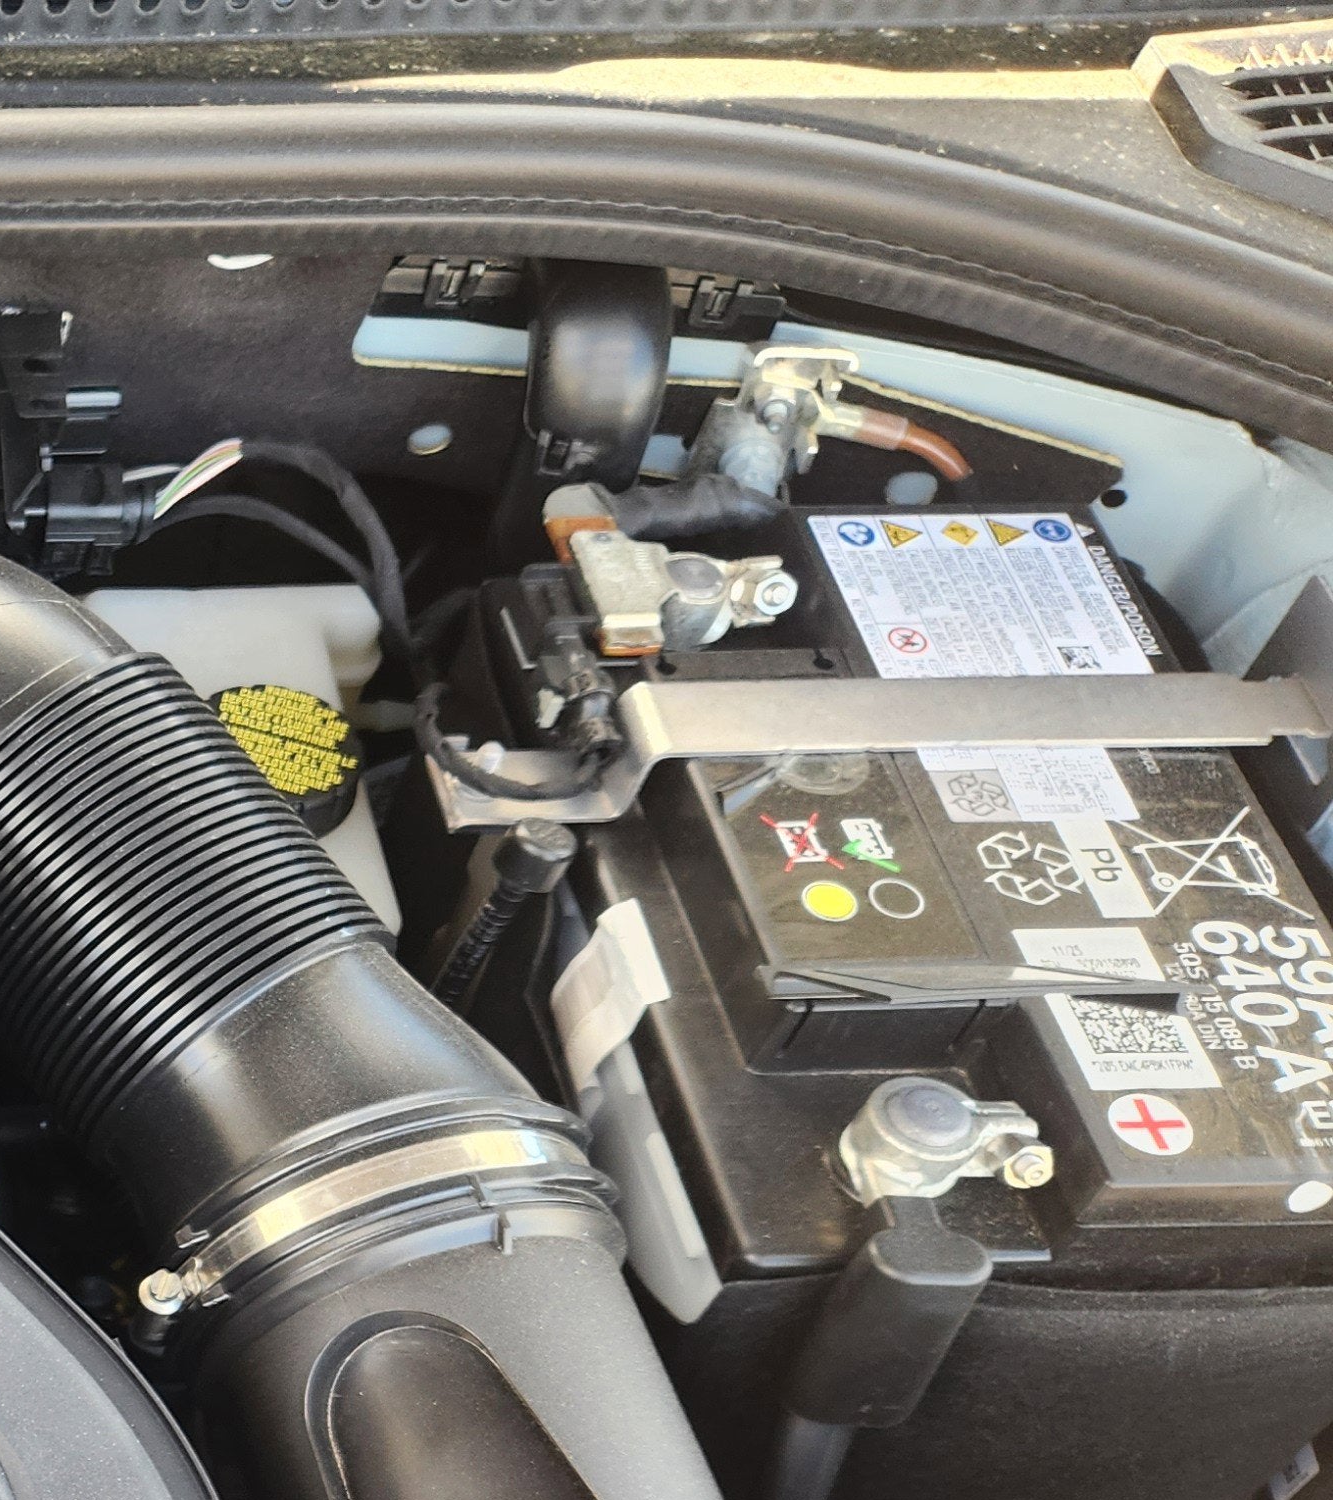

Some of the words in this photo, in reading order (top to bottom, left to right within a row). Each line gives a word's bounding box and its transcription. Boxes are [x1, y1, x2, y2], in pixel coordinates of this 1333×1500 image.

[1095, 545, 1163, 658] DANGER/POISON
[1079, 848, 1123, 882] Pb
[1191, 920, 1300, 1027] 640
[1254, 1045, 1333, 1093] A
[1214, 1018, 1250, 1051] 089
[1234, 1056, 1260, 1070] B
